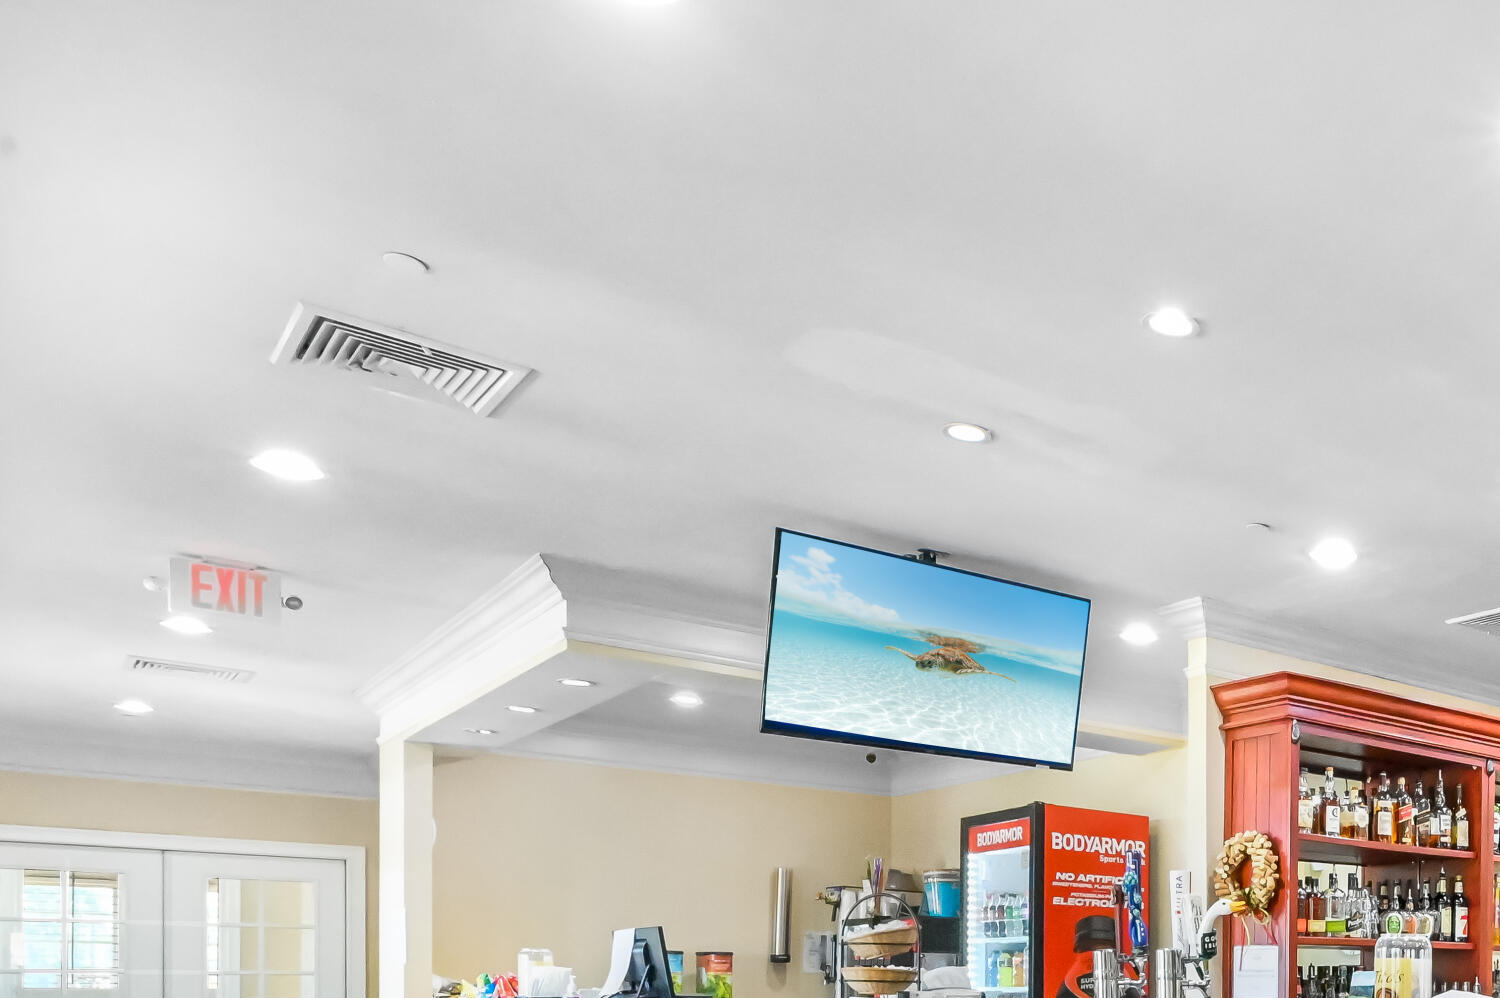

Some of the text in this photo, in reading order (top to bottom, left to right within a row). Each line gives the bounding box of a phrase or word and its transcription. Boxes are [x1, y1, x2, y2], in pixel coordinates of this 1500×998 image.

[191, 563, 267, 617] EXIT
[977, 826, 1023, 847] BODYARMOR
[1051, 832, 1147, 858] BODYARMOR
[1056, 872, 1125, 884] NO ARTIFIC
